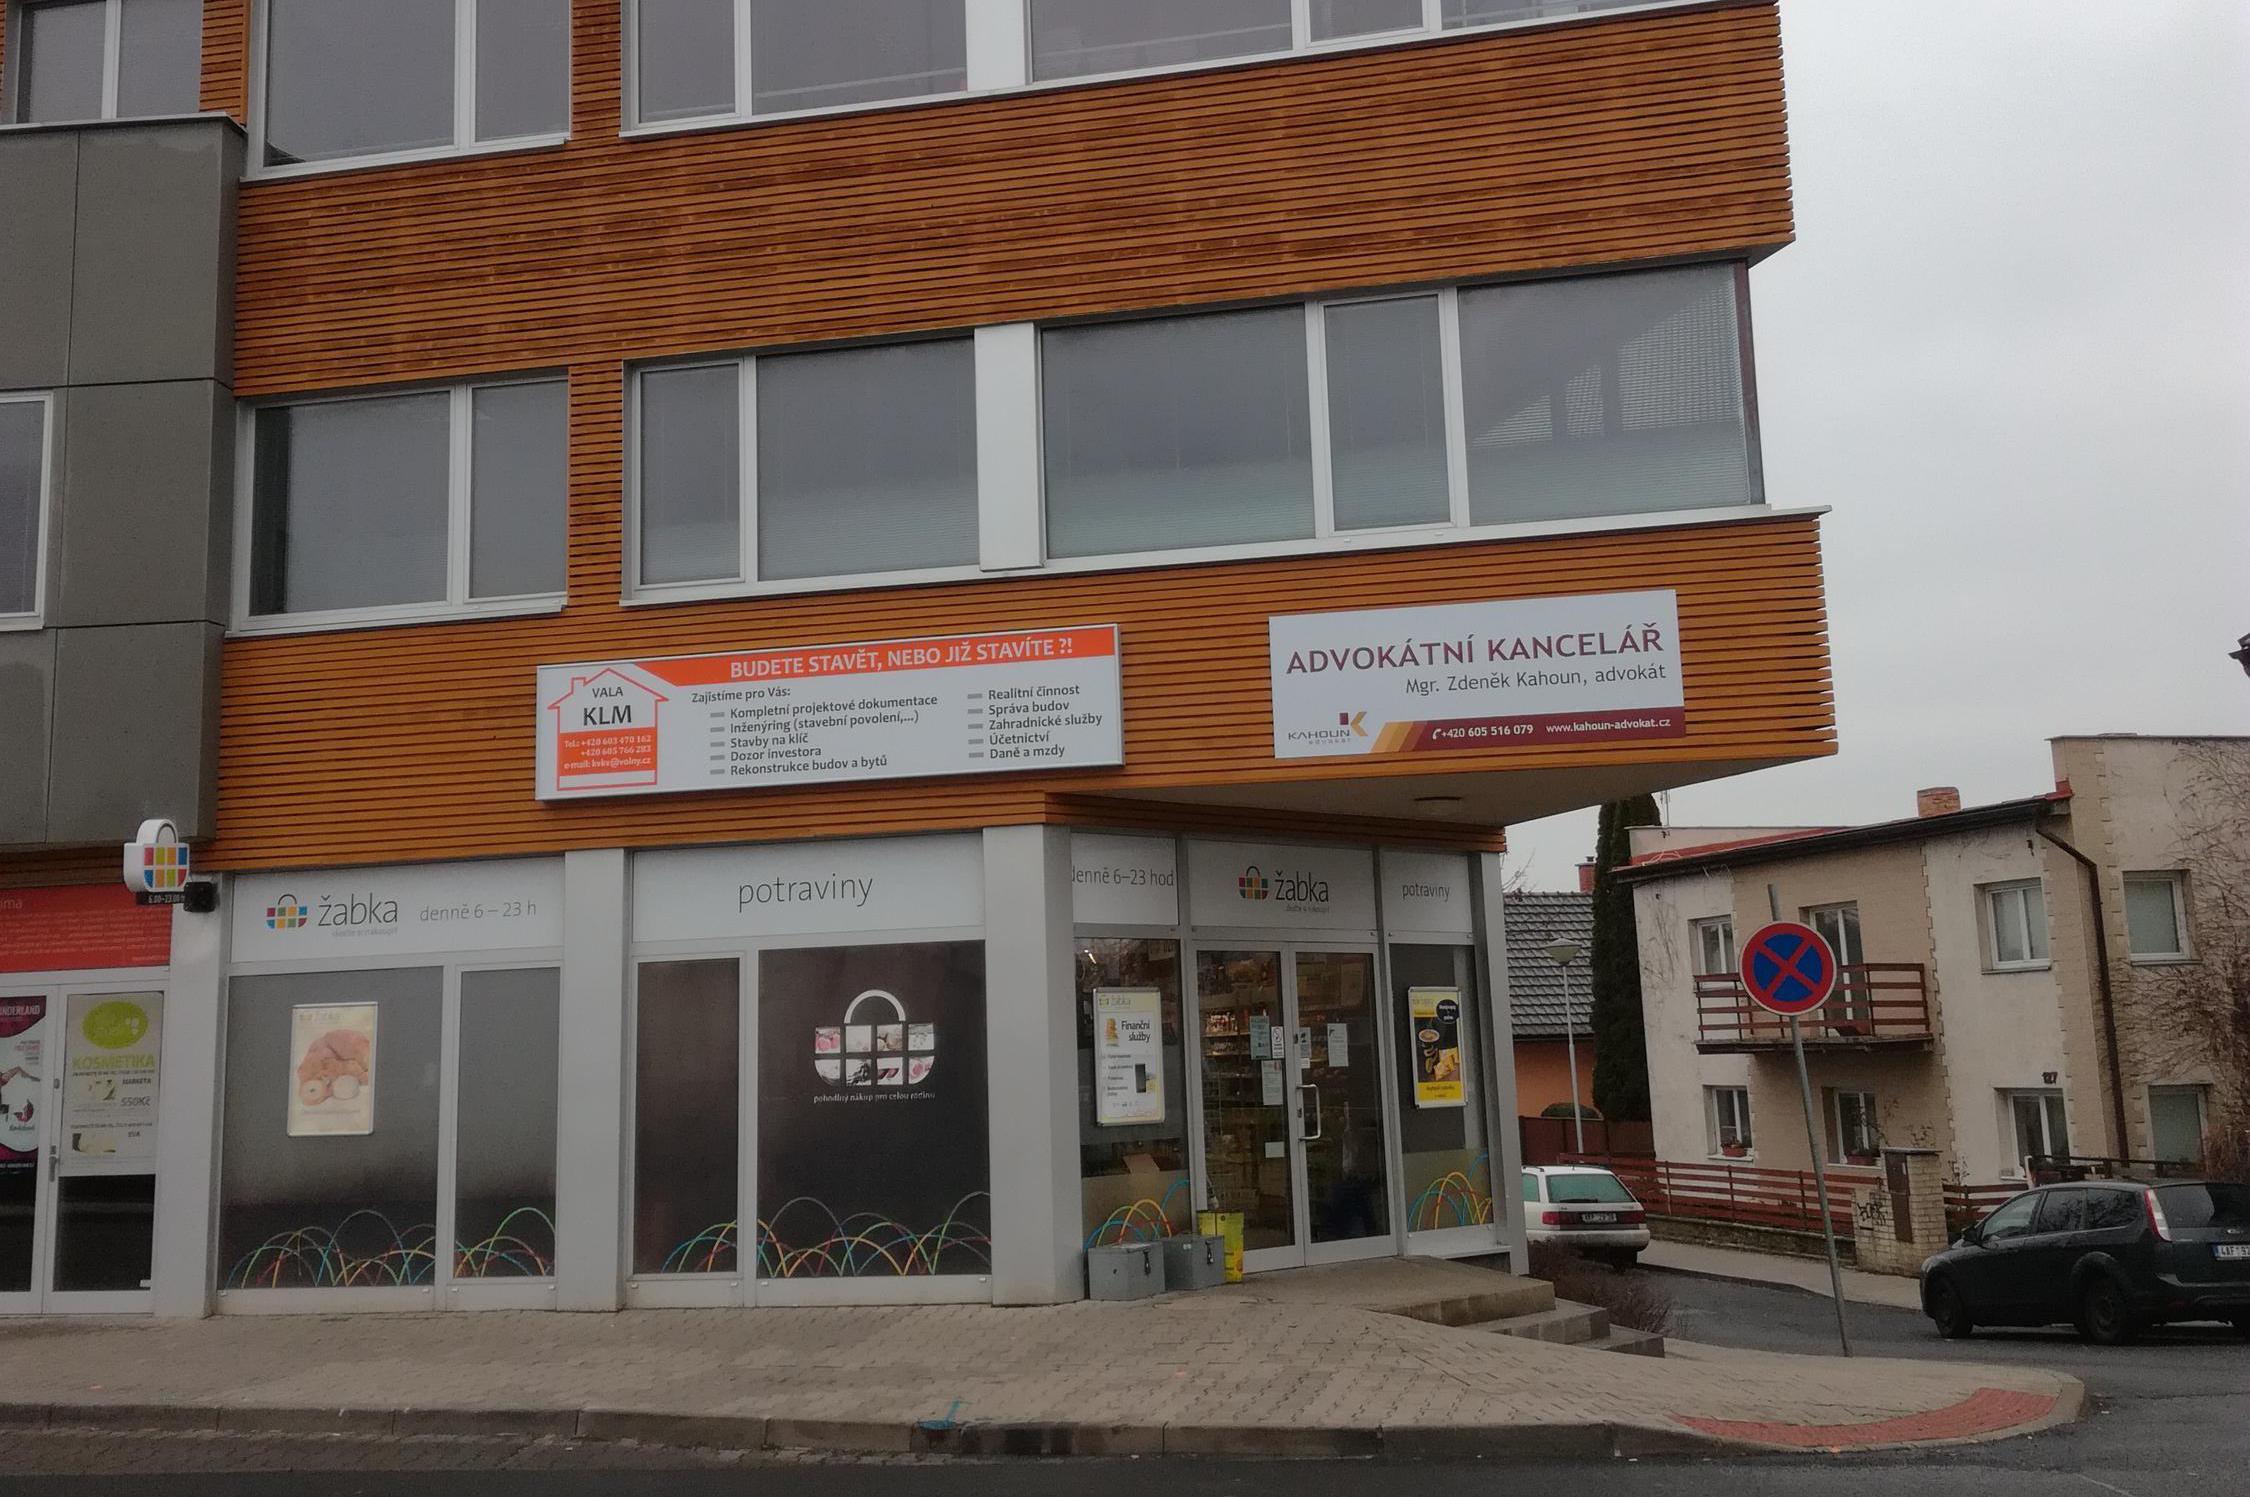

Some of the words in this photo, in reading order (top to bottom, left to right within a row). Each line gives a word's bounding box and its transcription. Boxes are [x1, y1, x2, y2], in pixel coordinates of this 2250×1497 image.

[1286, 633, 1474, 675] ADVOKÁTNÍ
[1488, 622, 1664, 662] KANCELÁŘ
[730, 657, 803, 679] BUDETE
[808, 649, 882, 672] STAVĚT,
[887, 647, 941, 668] NEBO
[945, 642, 971, 664] JIŽ
[977, 637, 1054, 661] STAVÍTE
[1059, 637, 1073, 655] ?!
[1406, 679, 1440, 696] Mgr.
[1448, 671, 1510, 692] Zdeněk
[1517, 671, 1588, 690] Kahoun,
[1595, 663, 1667, 683] advokát
[592, 686, 624, 699] VALA
[691, 690, 743, 706] Zajistíme
[745, 690, 765, 703] pro
[768, 686, 791, 699] Vás:
[988, 686, 1033, 700] Realitní
[1036, 684, 1080, 698] činnost
[583, 704, 632, 726] KLM
[730, 704, 790, 721] Kompletní
[792, 700, 855, 717] projektové
[858, 695, 938, 710] dokumentace
[988, 700, 1029, 718] Správa
[1032, 700, 1070, 713] budov
[730, 717, 791, 735] Inženýring
[793, 714, 847, 731] (stavební
[988, 714, 1062, 730] Zahradnické
[1064, 713, 1103, 727] služby
[1546, 719, 1671, 733] www.kahoun-advokat.cz
[989, 730, 1049, 745] Účetnictví
[1288, 730, 1350, 741] KAHOUN
[1441, 728, 1465, 739] +420
[1468, 727, 1488, 738] 605
[1491, 725, 1511, 736] 516
[1513, 724, 1534, 735] 079
[581, 738, 601, 747] +420
[730, 735, 769, 749] Stavby
[771, 736, 786, 746] na
[788, 733, 809, 745] klíč
[581, 747, 601, 757] +420
[730, 750, 764, 762] Dozor
[767, 746, 822, 759] investora
[989, 746, 1020, 759] Daně
[1023, 748, 1030, 757] a
[1033, 745, 1065, 758] mzdy
[730, 758, 809, 776] Rekonstrukce
[812, 757, 848, 771] budov
[851, 759, 858, 768] a
[861, 754, 887, 770] bytů
[1150, 868, 1174, 887] hod
[1274, 869, 1329, 902] žabka
[739, 873, 873, 913] potraviny
[1402, 881, 1450, 903] potraviny
[318, 892, 398, 927] žabka
[420, 903, 470, 921] denně
[474, 903, 484, 919] 6
[503, 901, 522, 917] 23
[527, 900, 536, 916] h
[1121, 1019, 1150, 1031] Finanční
[1128, 1031, 1151, 1043] služby
